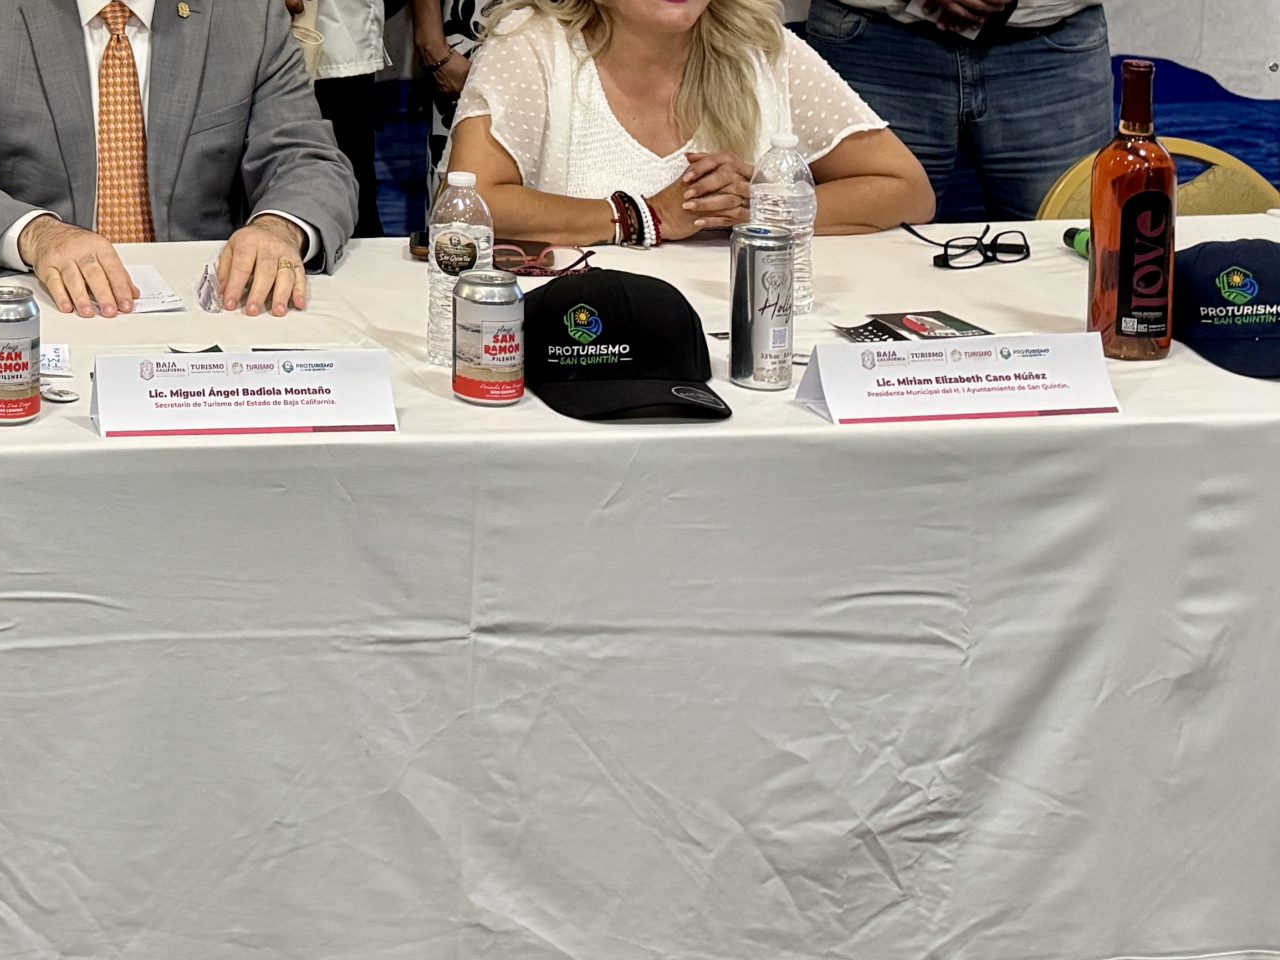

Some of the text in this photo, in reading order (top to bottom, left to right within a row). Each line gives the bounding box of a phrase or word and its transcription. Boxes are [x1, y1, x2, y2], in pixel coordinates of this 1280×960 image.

[1131, 210, 1168, 309] love
[758, 294, 792, 324] Holly
[1213, 314, 1277, 325] SAN QUINTÍN
[492, 333, 516, 344] SAN
[483, 343, 520, 356] RAMÓN
[548, 344, 630, 356] PROTURISMO
[910, 351, 944, 359] TURISMO
[964, 350, 992, 358] TURISMO
[155, 361, 177, 369] BAJA
[560, 354, 619, 366] SAN QUINTÍN
[876, 372, 1047, 387] Lic. Miriam Elizabeth Cano Núñez
[149, 385, 331, 399] Lic. Miguel Ángel Badiola Montaño
[967, 385, 1015, 394] Ayuntamiento
[154, 401, 191, 409] Secretario
[203, 400, 232, 408] Turismo
[283, 399, 299, 407] Baja
[301, 398, 336, 406] California.
